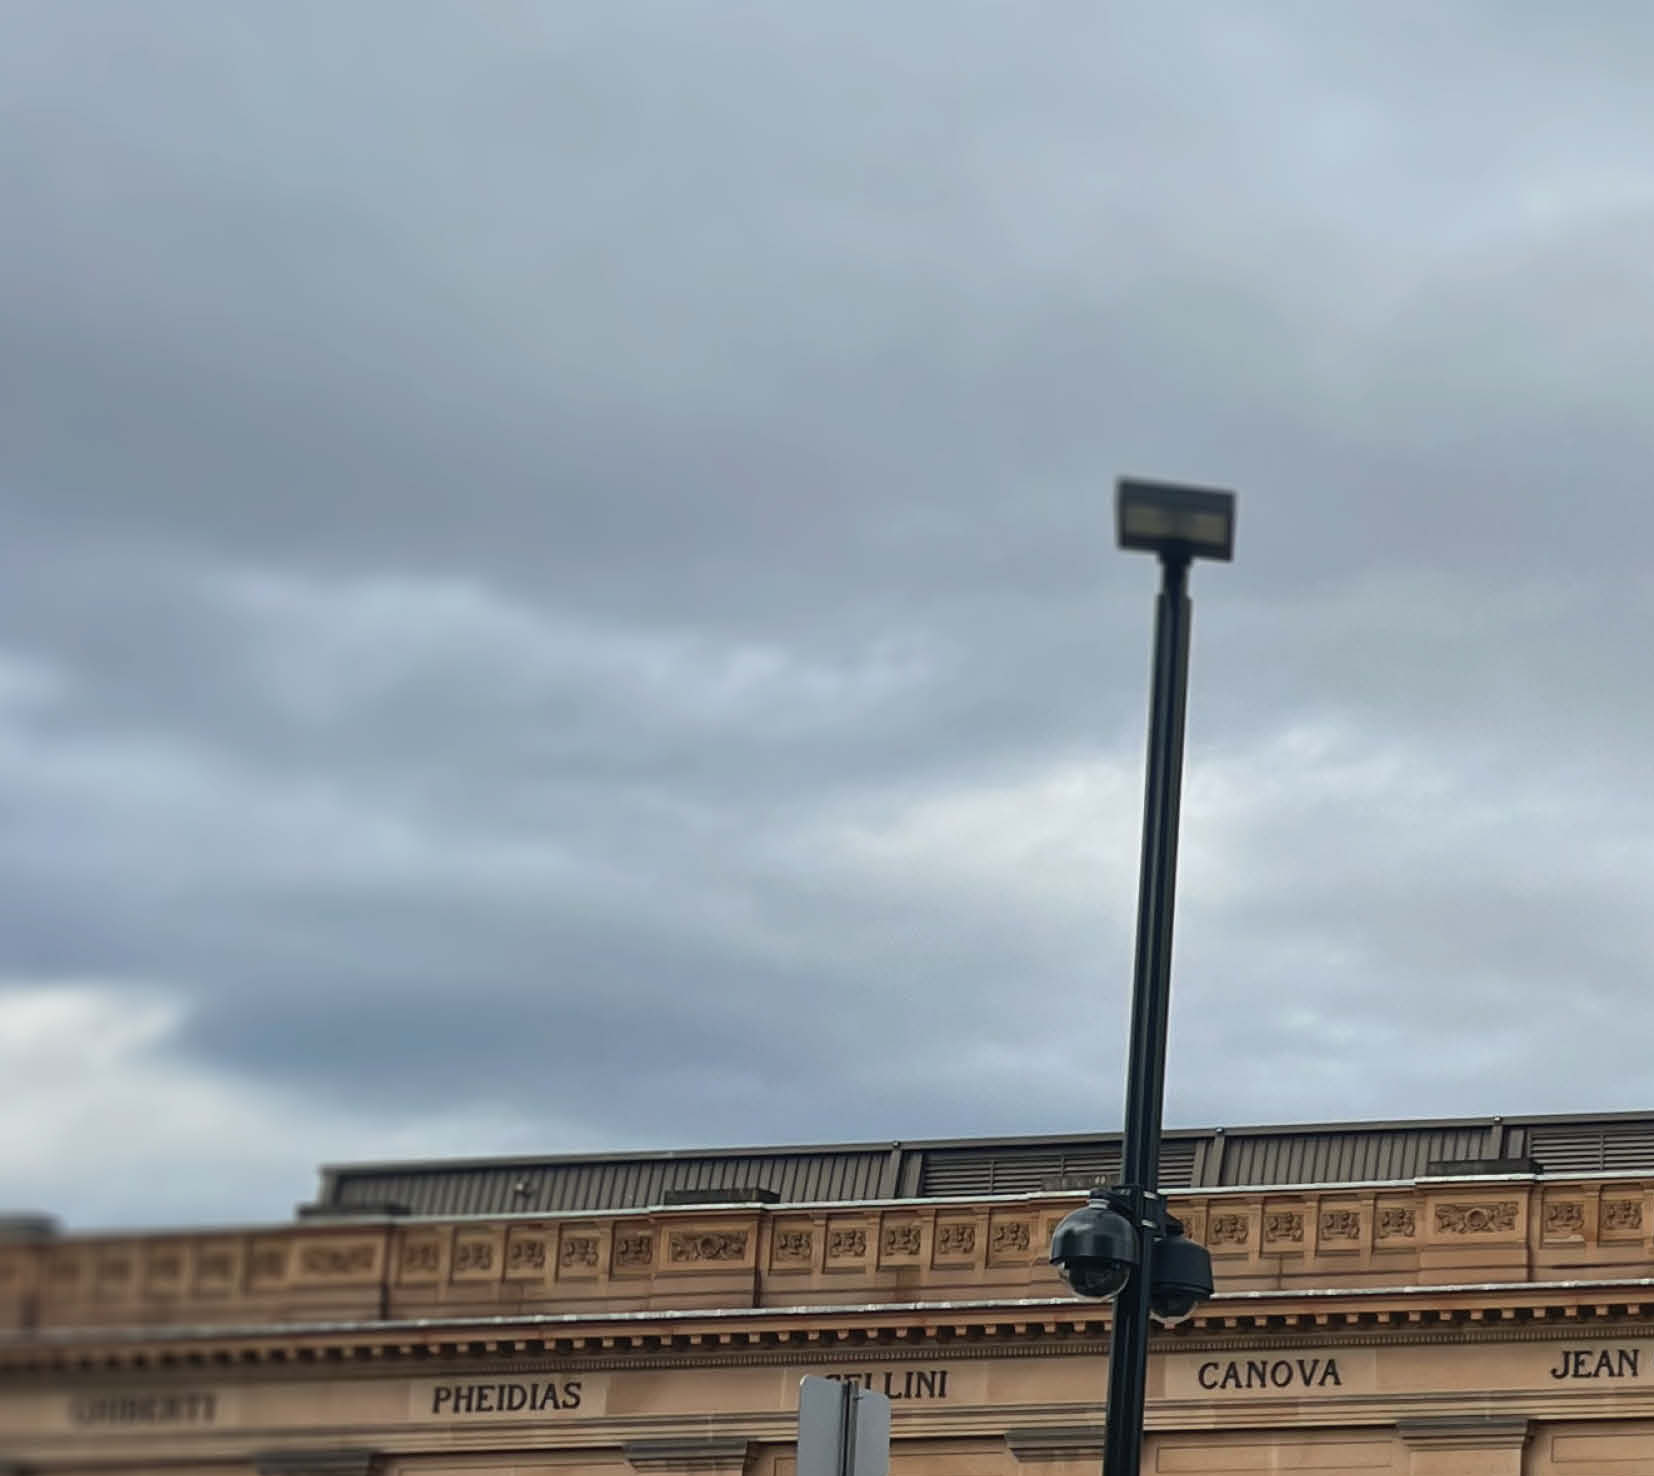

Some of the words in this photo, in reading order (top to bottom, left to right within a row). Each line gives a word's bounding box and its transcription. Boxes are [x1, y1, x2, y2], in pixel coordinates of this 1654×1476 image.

[1198, 1358, 1342, 1390] CANOVA
[1550, 1348, 1640, 1380] JEAN
[433, 1381, 582, 1414] PHEIDIAS
